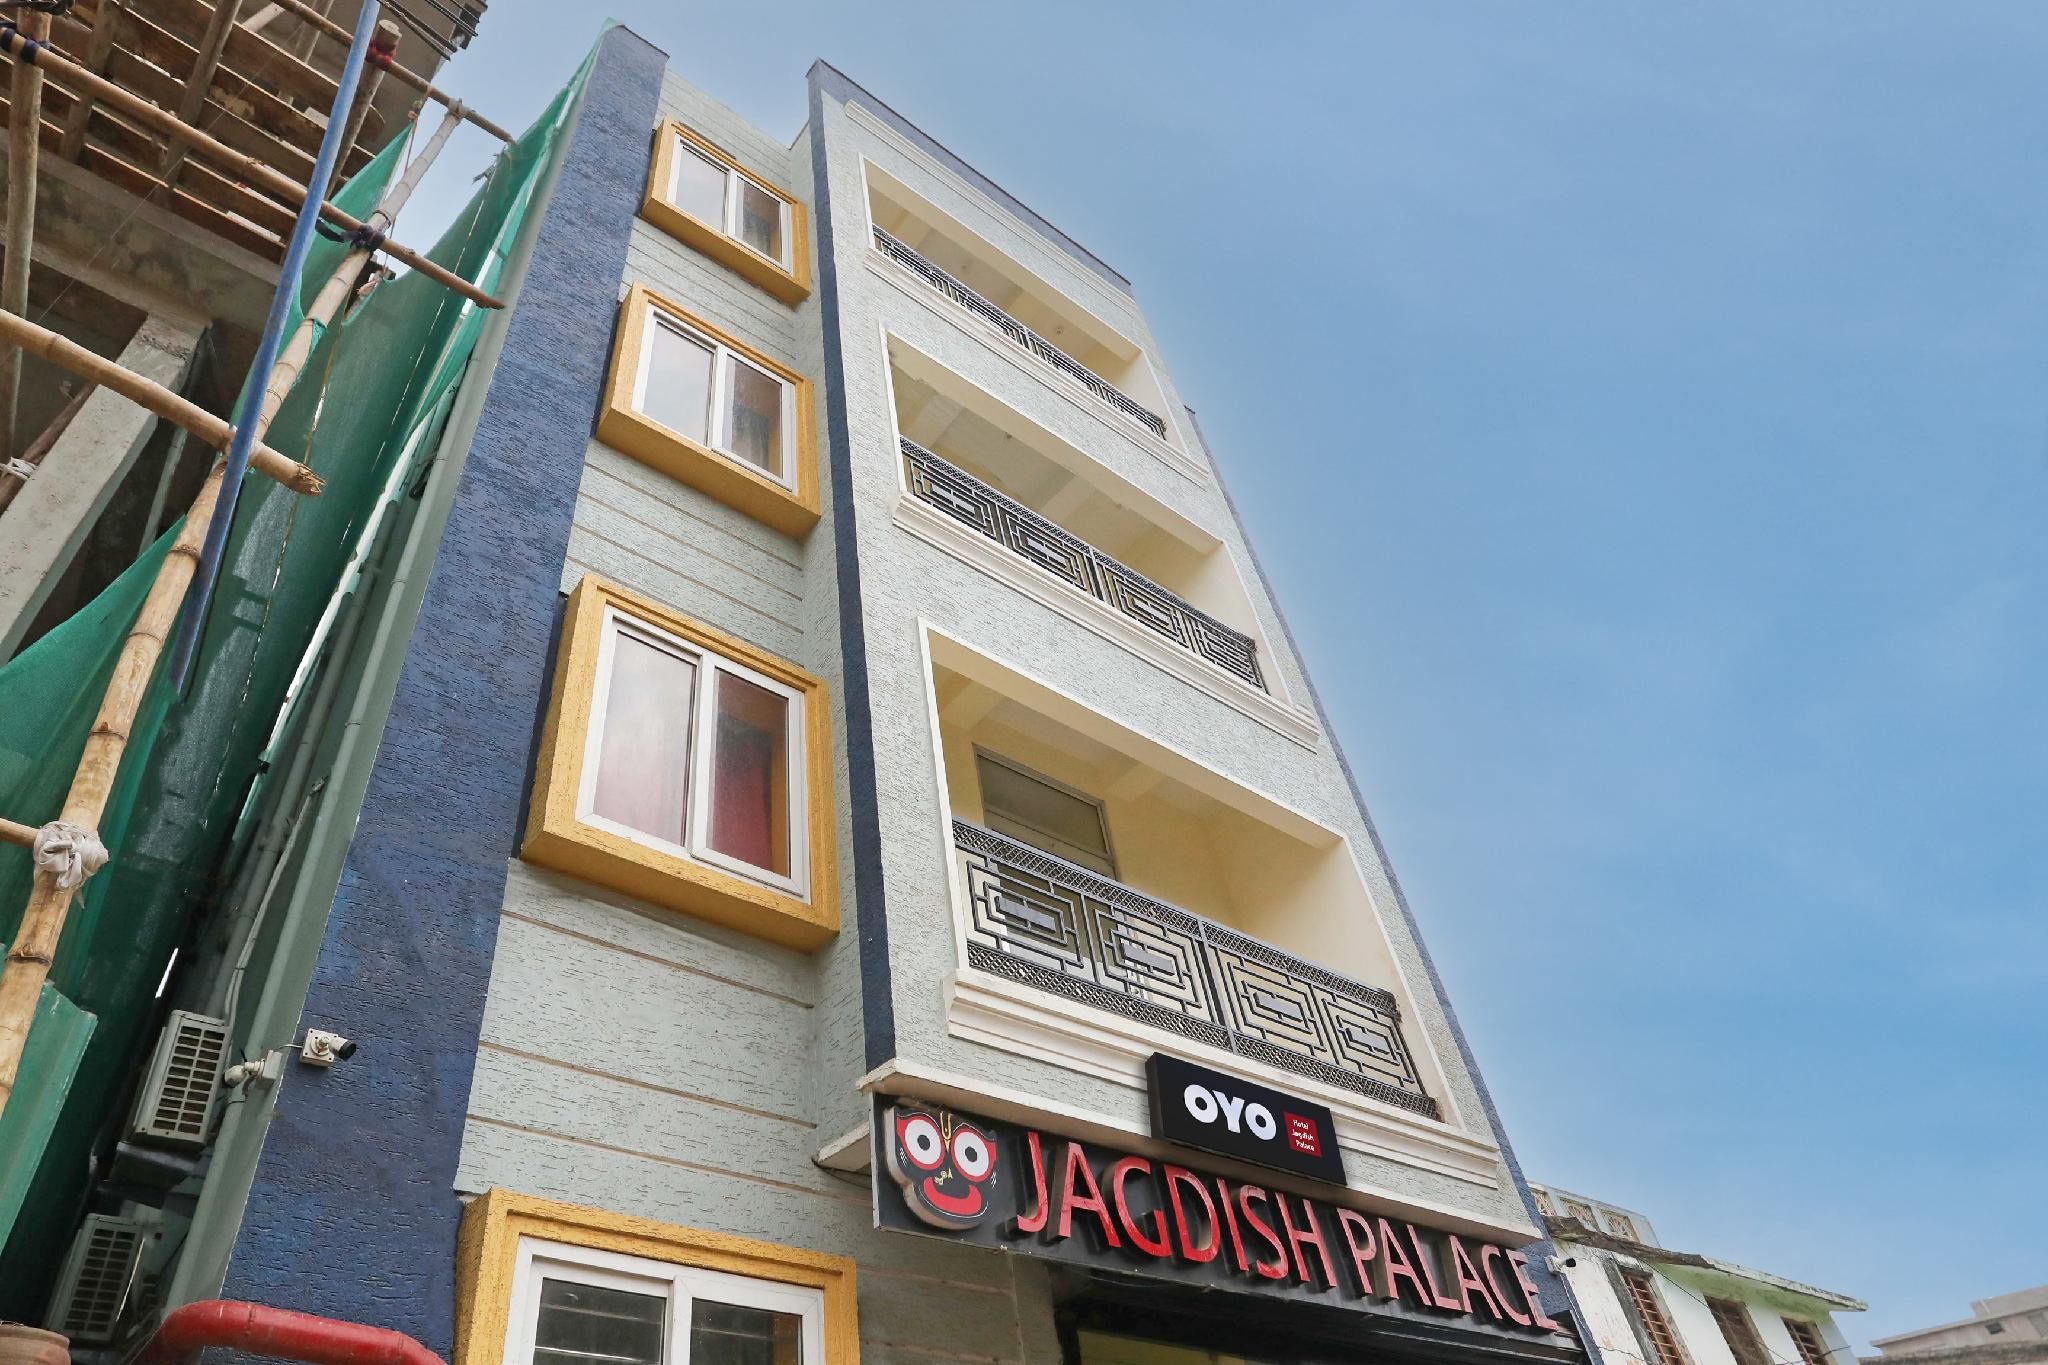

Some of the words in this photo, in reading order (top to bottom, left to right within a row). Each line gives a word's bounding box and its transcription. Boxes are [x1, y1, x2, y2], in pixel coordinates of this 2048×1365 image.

[1184, 1084, 1277, 1141] OYO
[1292, 1119, 1309, 1130] Hotel
[1292, 1129, 1315, 1142] Jagdish
[1295, 1139, 1315, 1152] Palace
[1016, 1131, 1337, 1291] JAGDISH
[1337, 1207, 1559, 1332] PALACE
